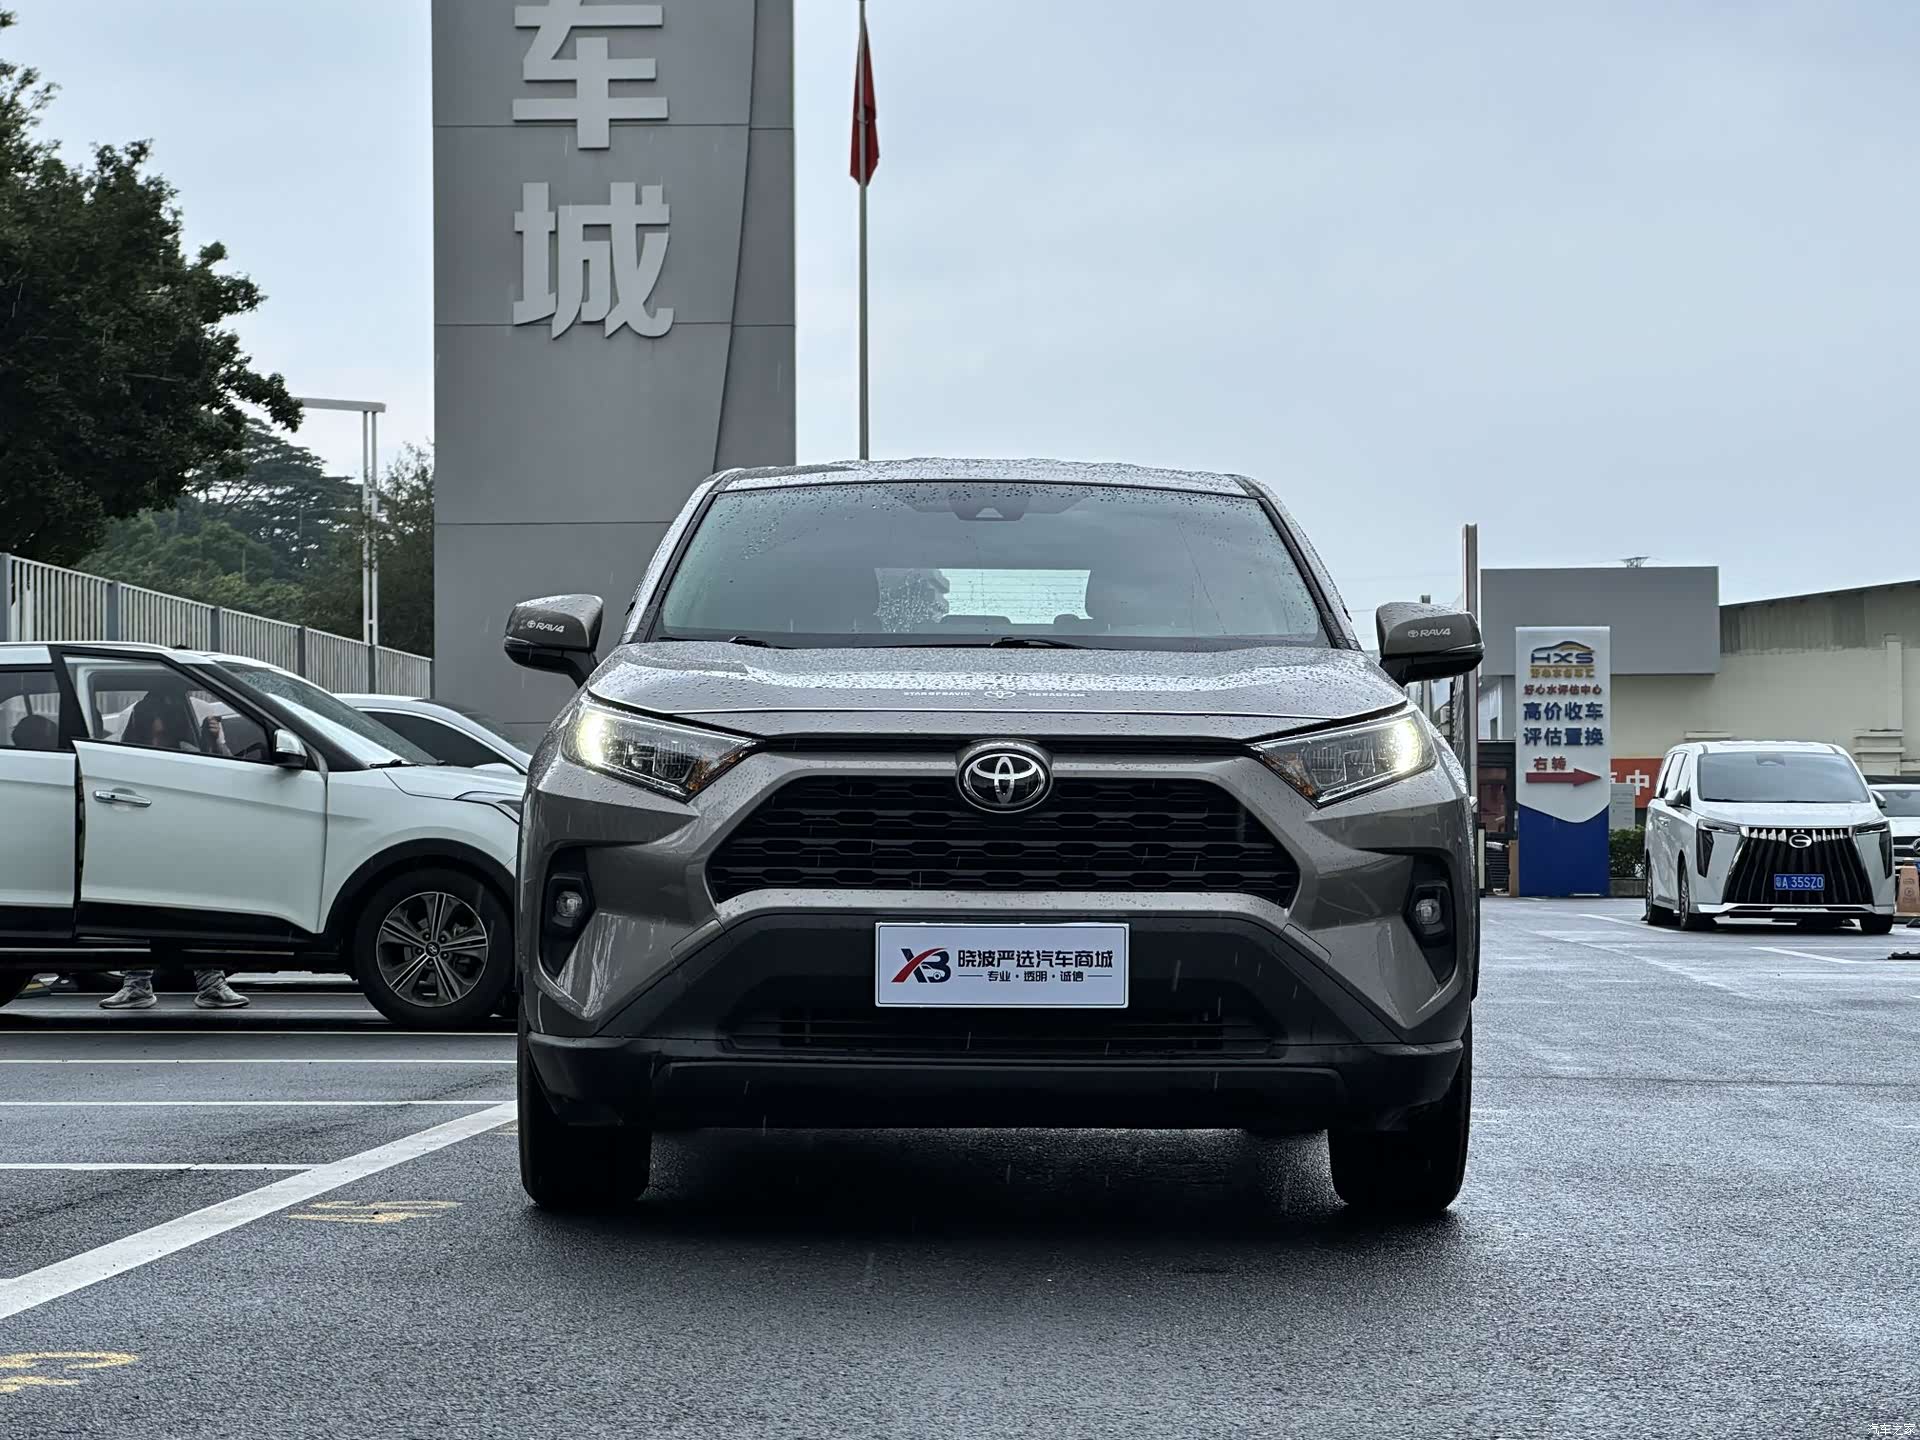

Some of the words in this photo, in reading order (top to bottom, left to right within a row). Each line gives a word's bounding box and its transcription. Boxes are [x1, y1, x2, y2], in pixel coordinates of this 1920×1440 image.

[513, 0, 674, 340] 车城
[535, 622, 565, 633] RAV4
[1420, 627, 1451, 637] RAV4
[1530, 652, 1594, 664] HXS
[1523, 683, 1603, 696] 好心水评估中心
[1523, 702, 1604, 721] 高价收车
[1523, 727, 1604, 746] 评估置换
[1533, 756, 1567, 771] 右转
[957, 950, 1113, 968] 晓波严选汽车商城
